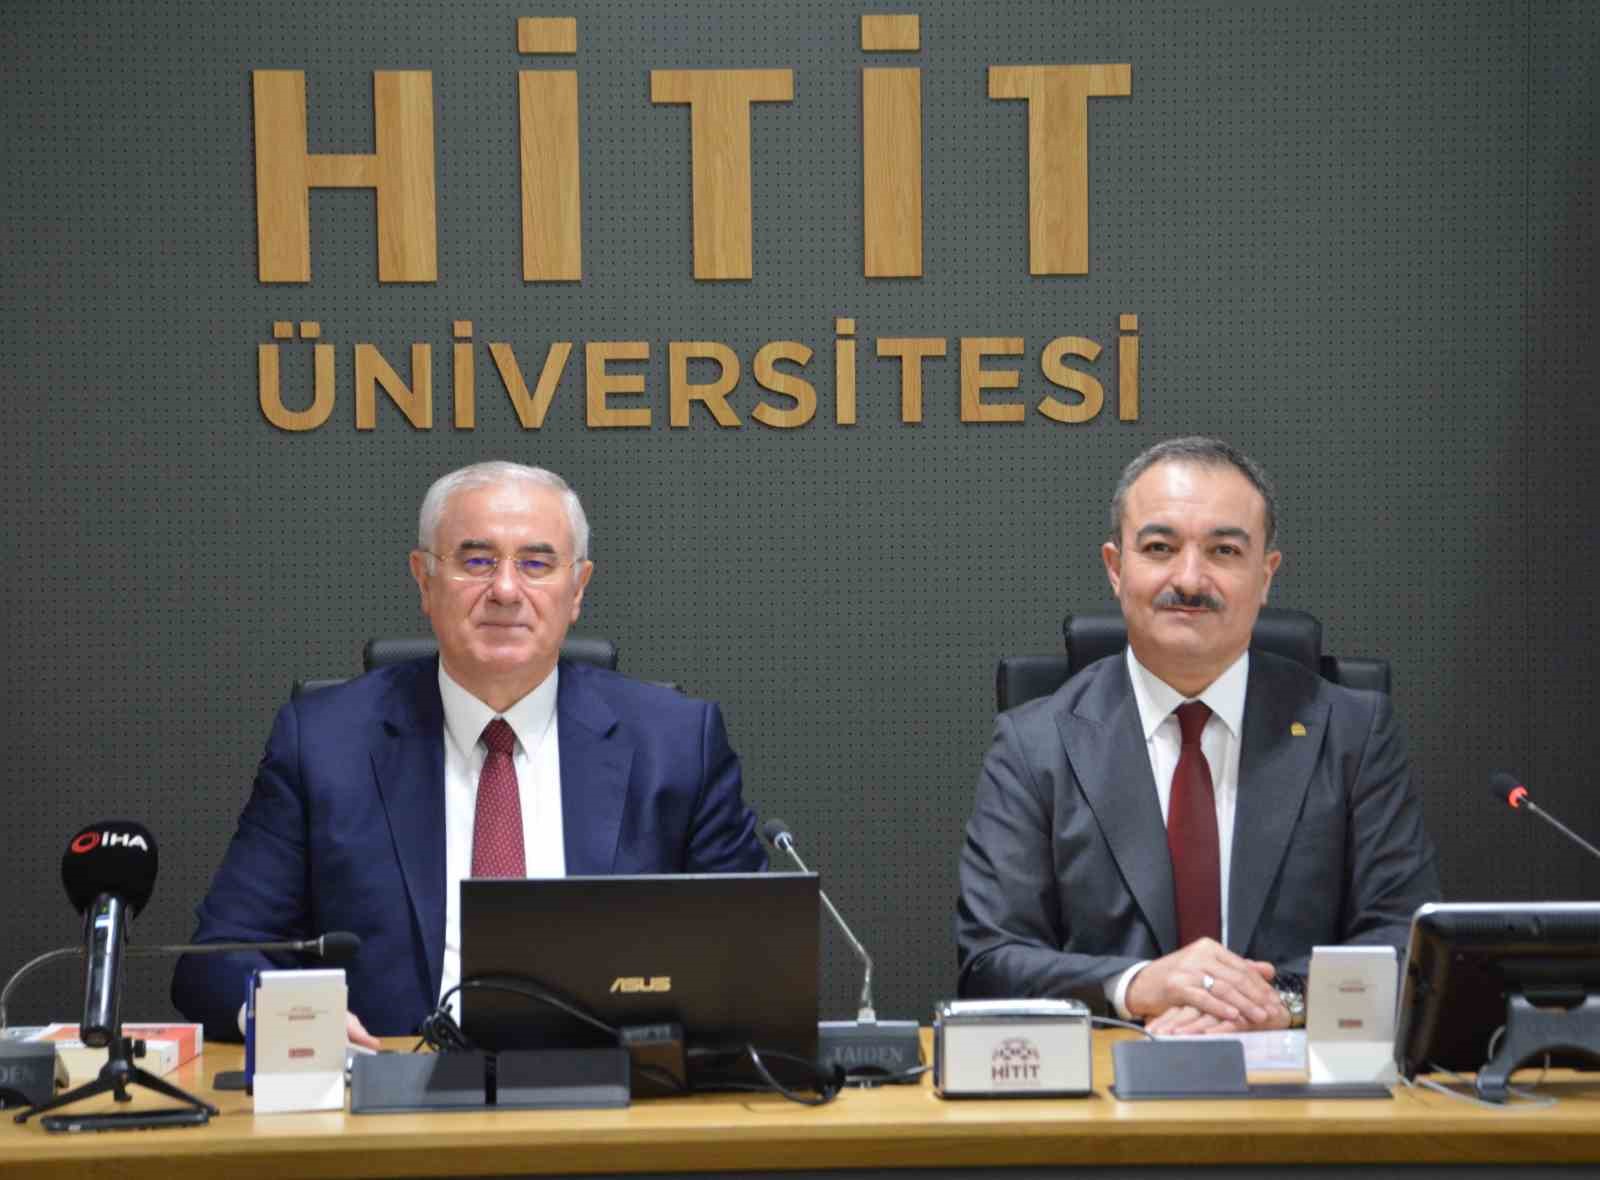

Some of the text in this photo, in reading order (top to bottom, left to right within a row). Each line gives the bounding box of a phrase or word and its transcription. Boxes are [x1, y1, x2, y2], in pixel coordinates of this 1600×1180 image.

[252, 15, 1132, 283] HİTİT
[258, 314, 1139, 431] ÜNİVERSİTESİ
[609, 976, 671, 993] ASUS
